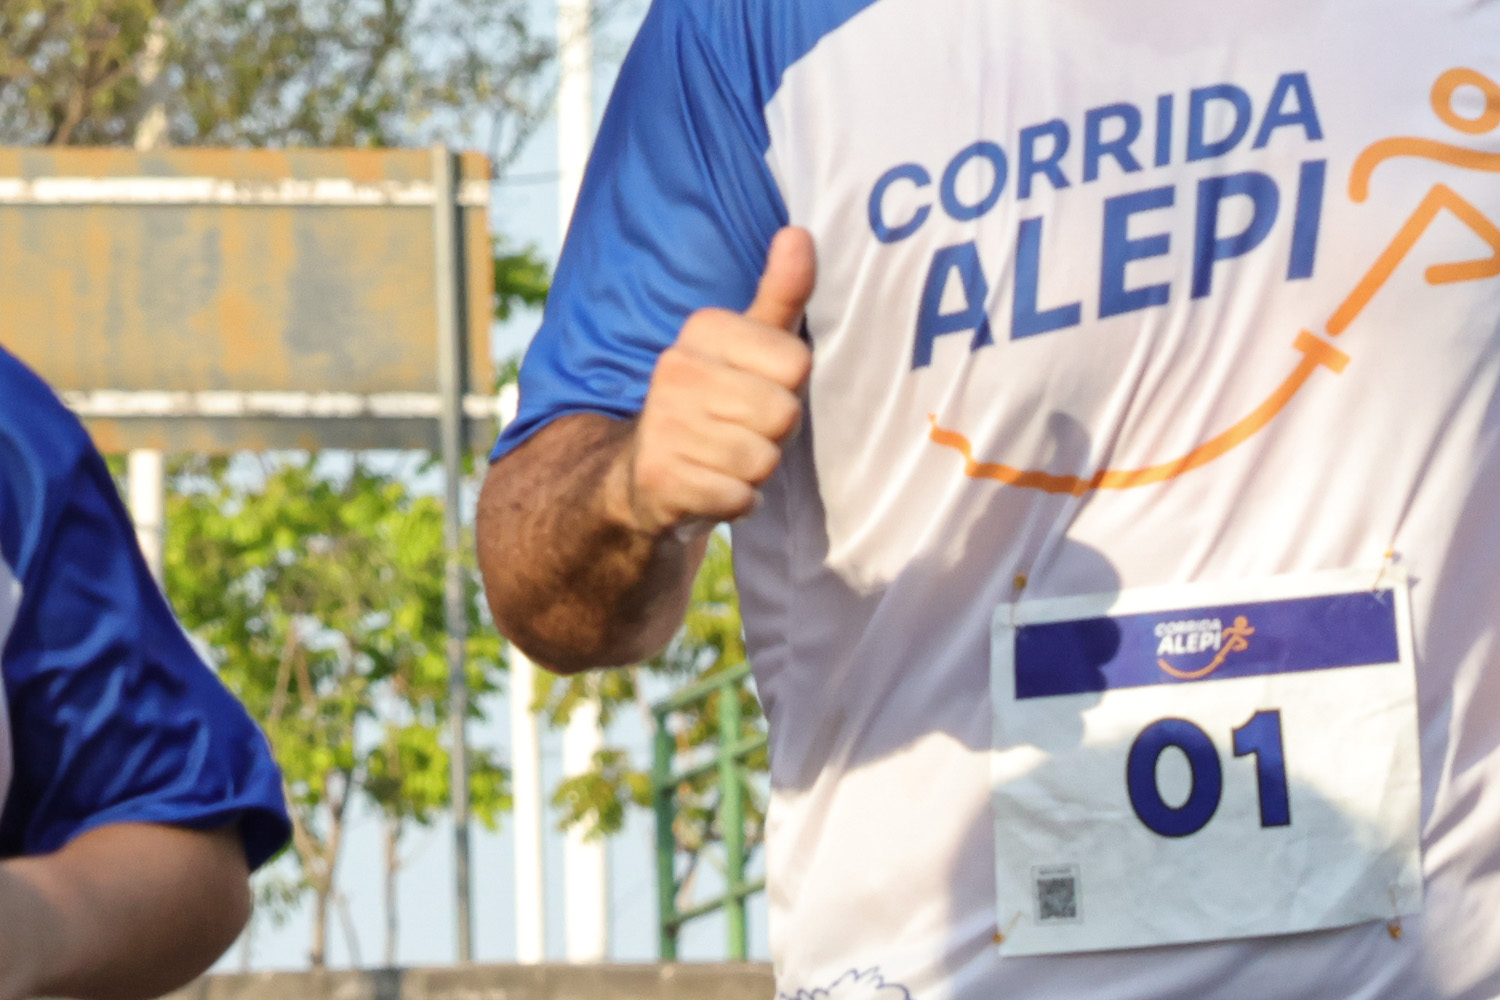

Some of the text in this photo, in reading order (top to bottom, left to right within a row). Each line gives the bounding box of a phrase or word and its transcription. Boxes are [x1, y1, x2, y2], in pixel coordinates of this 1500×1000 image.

[867, 71, 1324, 244] CORRIDA
[911, 159, 1327, 371] ALEPI
[1154, 618, 1222, 637] CORRIDA
[1157, 632, 1222, 655] ALEPI
[1126, 708, 1291, 839] 01
